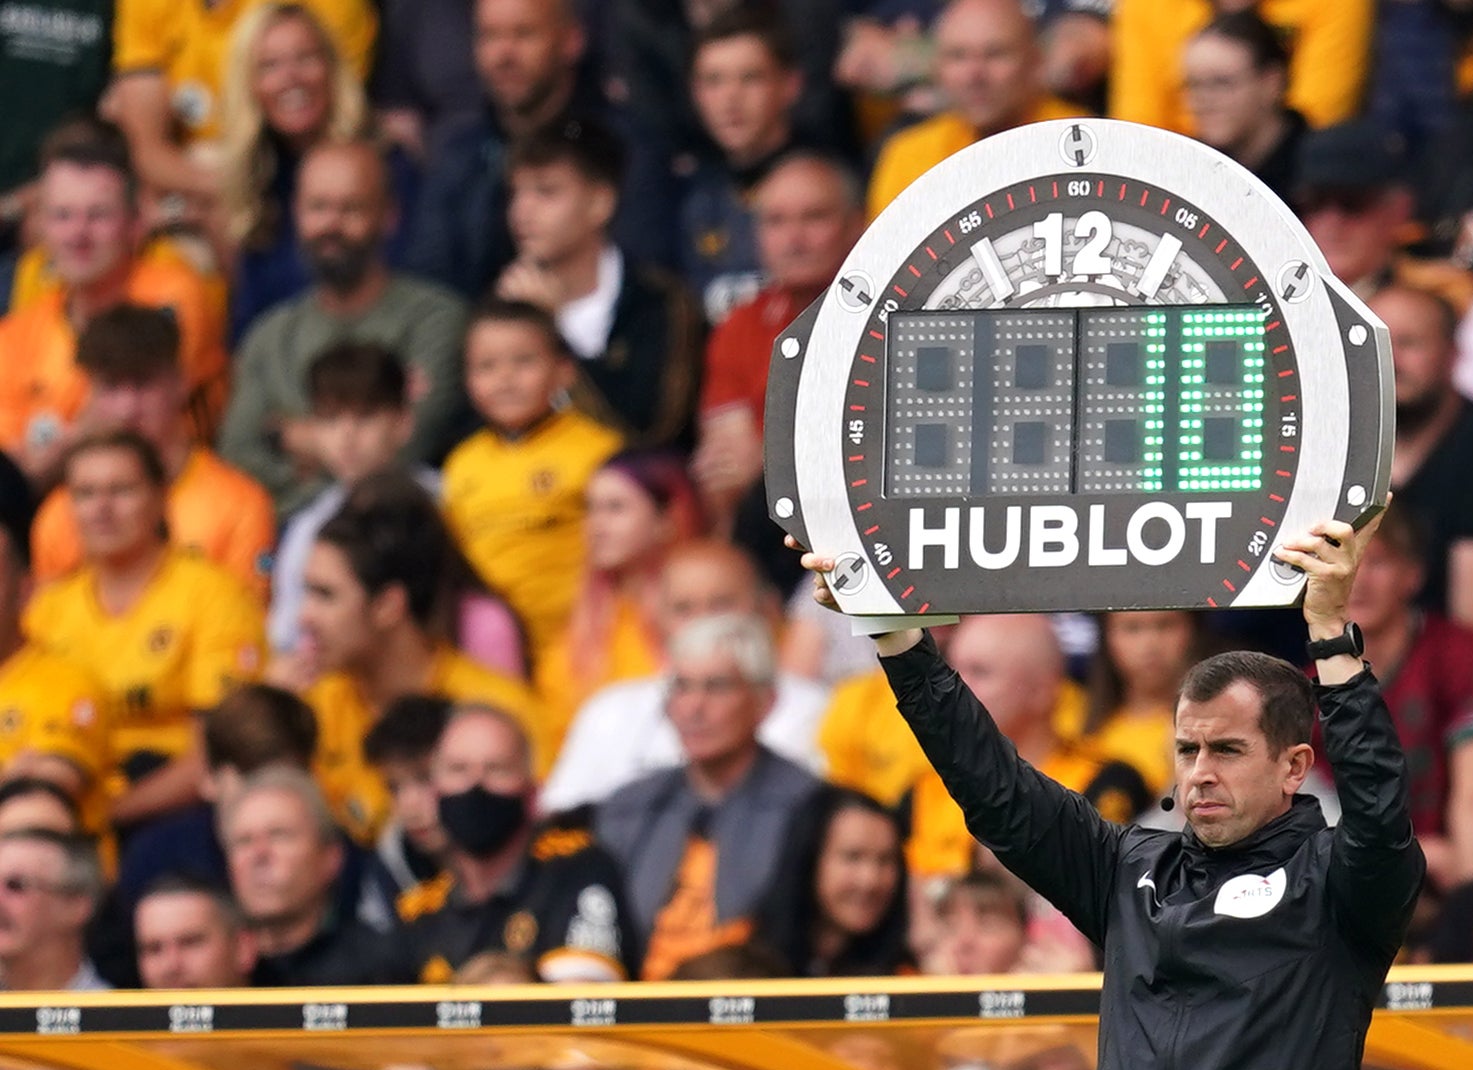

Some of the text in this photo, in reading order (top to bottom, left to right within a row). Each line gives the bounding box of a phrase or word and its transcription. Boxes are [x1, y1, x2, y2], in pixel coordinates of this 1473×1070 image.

[1067, 180, 1091, 197] 60
[957, 210, 983, 235] 55
[1174, 207, 1199, 230] 05
[1033, 210, 1114, 276] 12
[1142, 311, 1267, 491] 10
[848, 418, 865, 446] 45
[1280, 411, 1298, 438] 15
[908, 501, 1233, 571] HUBLOT
[1246, 530, 1269, 557] 20
[872, 541, 894, 567] 40
